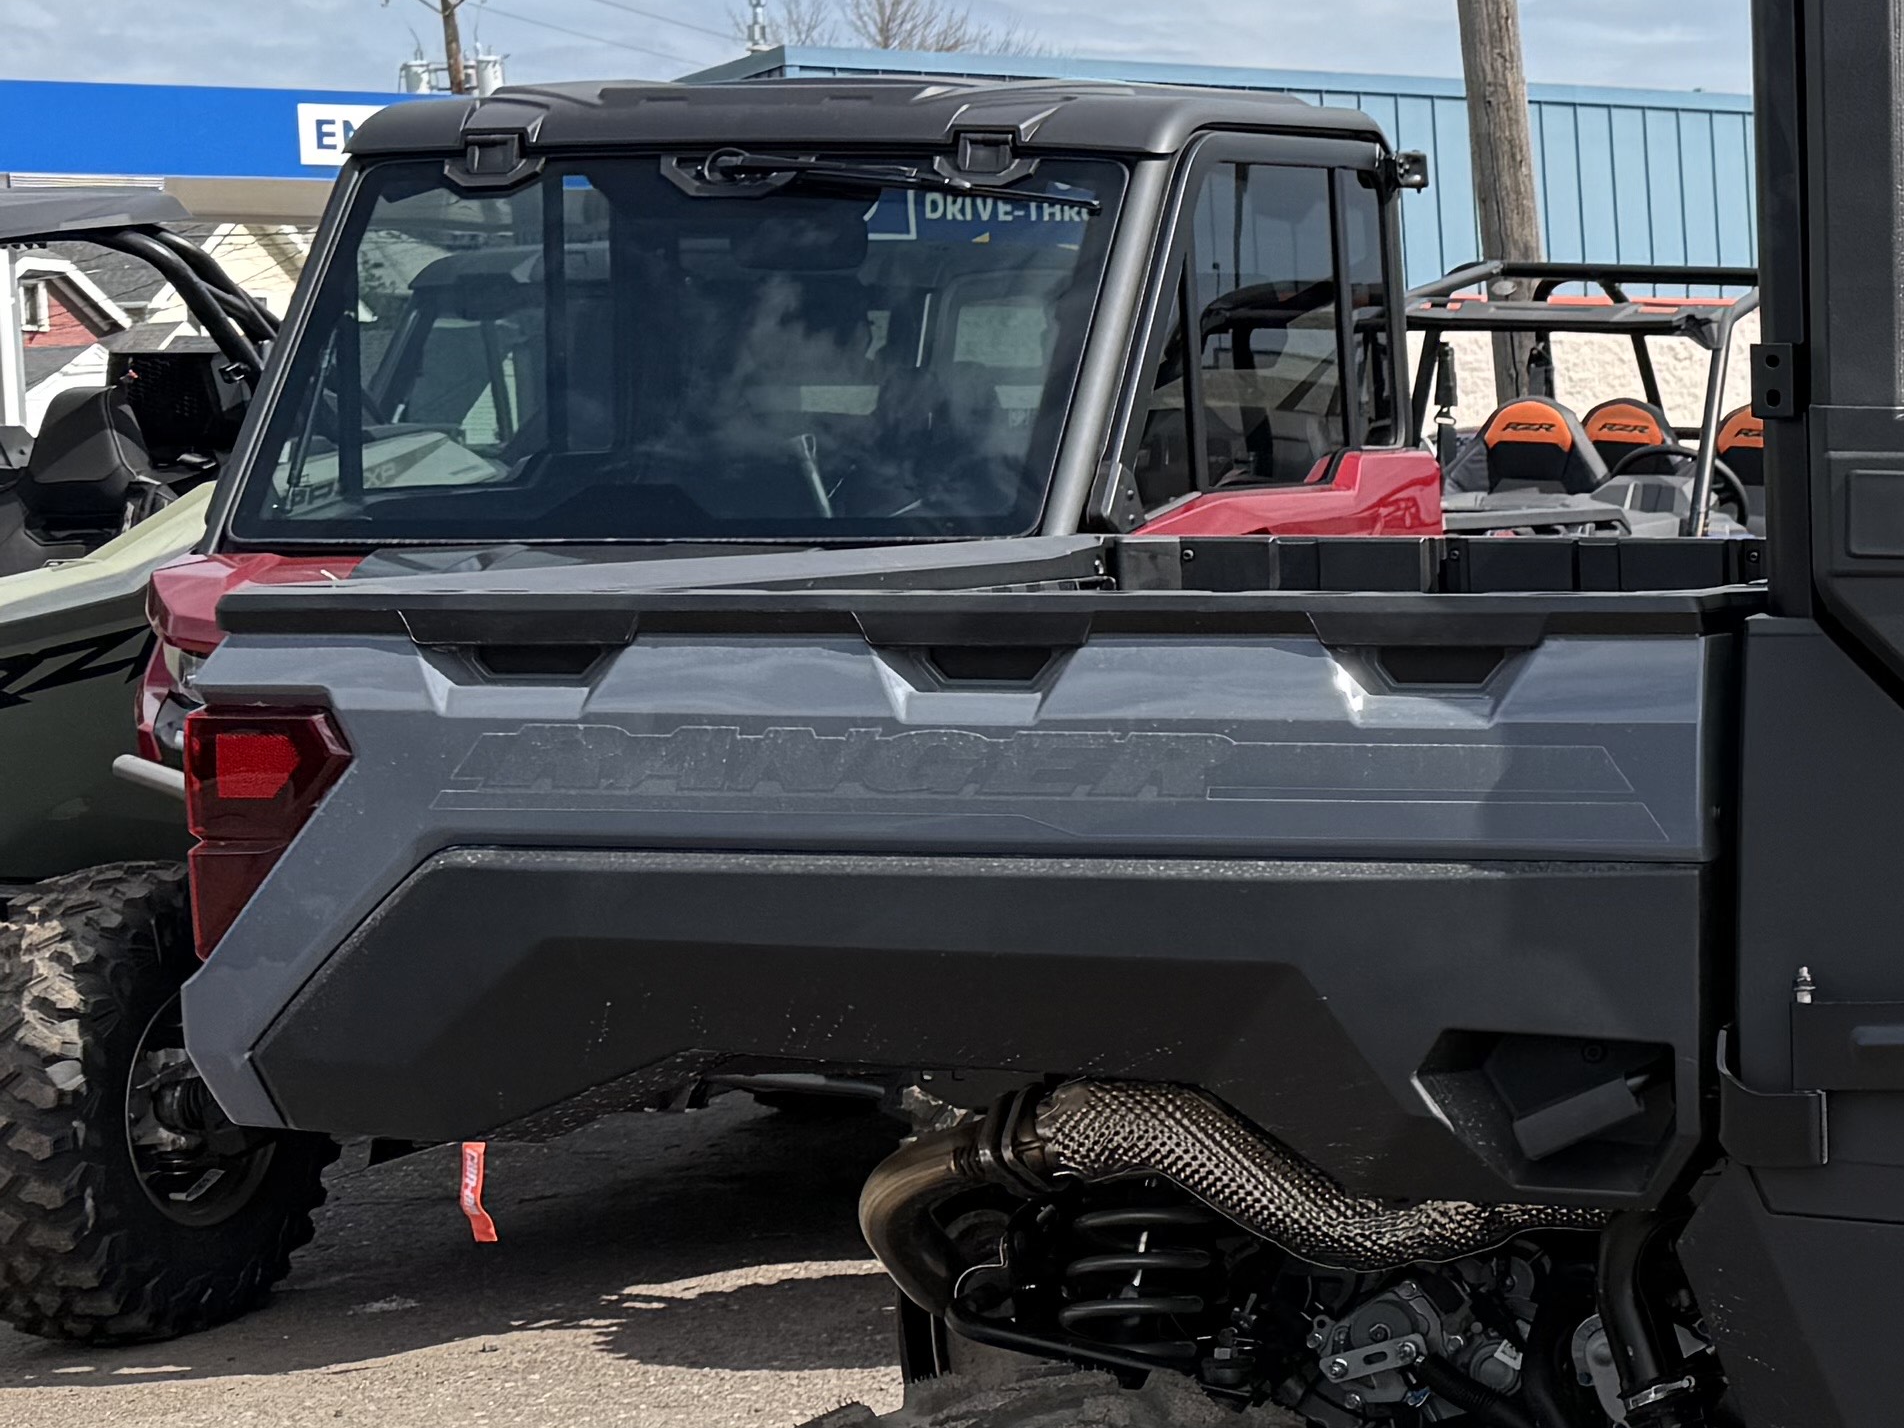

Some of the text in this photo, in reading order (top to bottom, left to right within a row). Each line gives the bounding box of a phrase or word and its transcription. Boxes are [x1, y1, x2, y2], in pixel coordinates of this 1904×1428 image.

[1502, 422, 1556, 433] RZR
[1598, 422, 1650, 434] RZR
[1734, 428, 1763, 438] RZ
[474, 724, 1236, 798] RANGER
